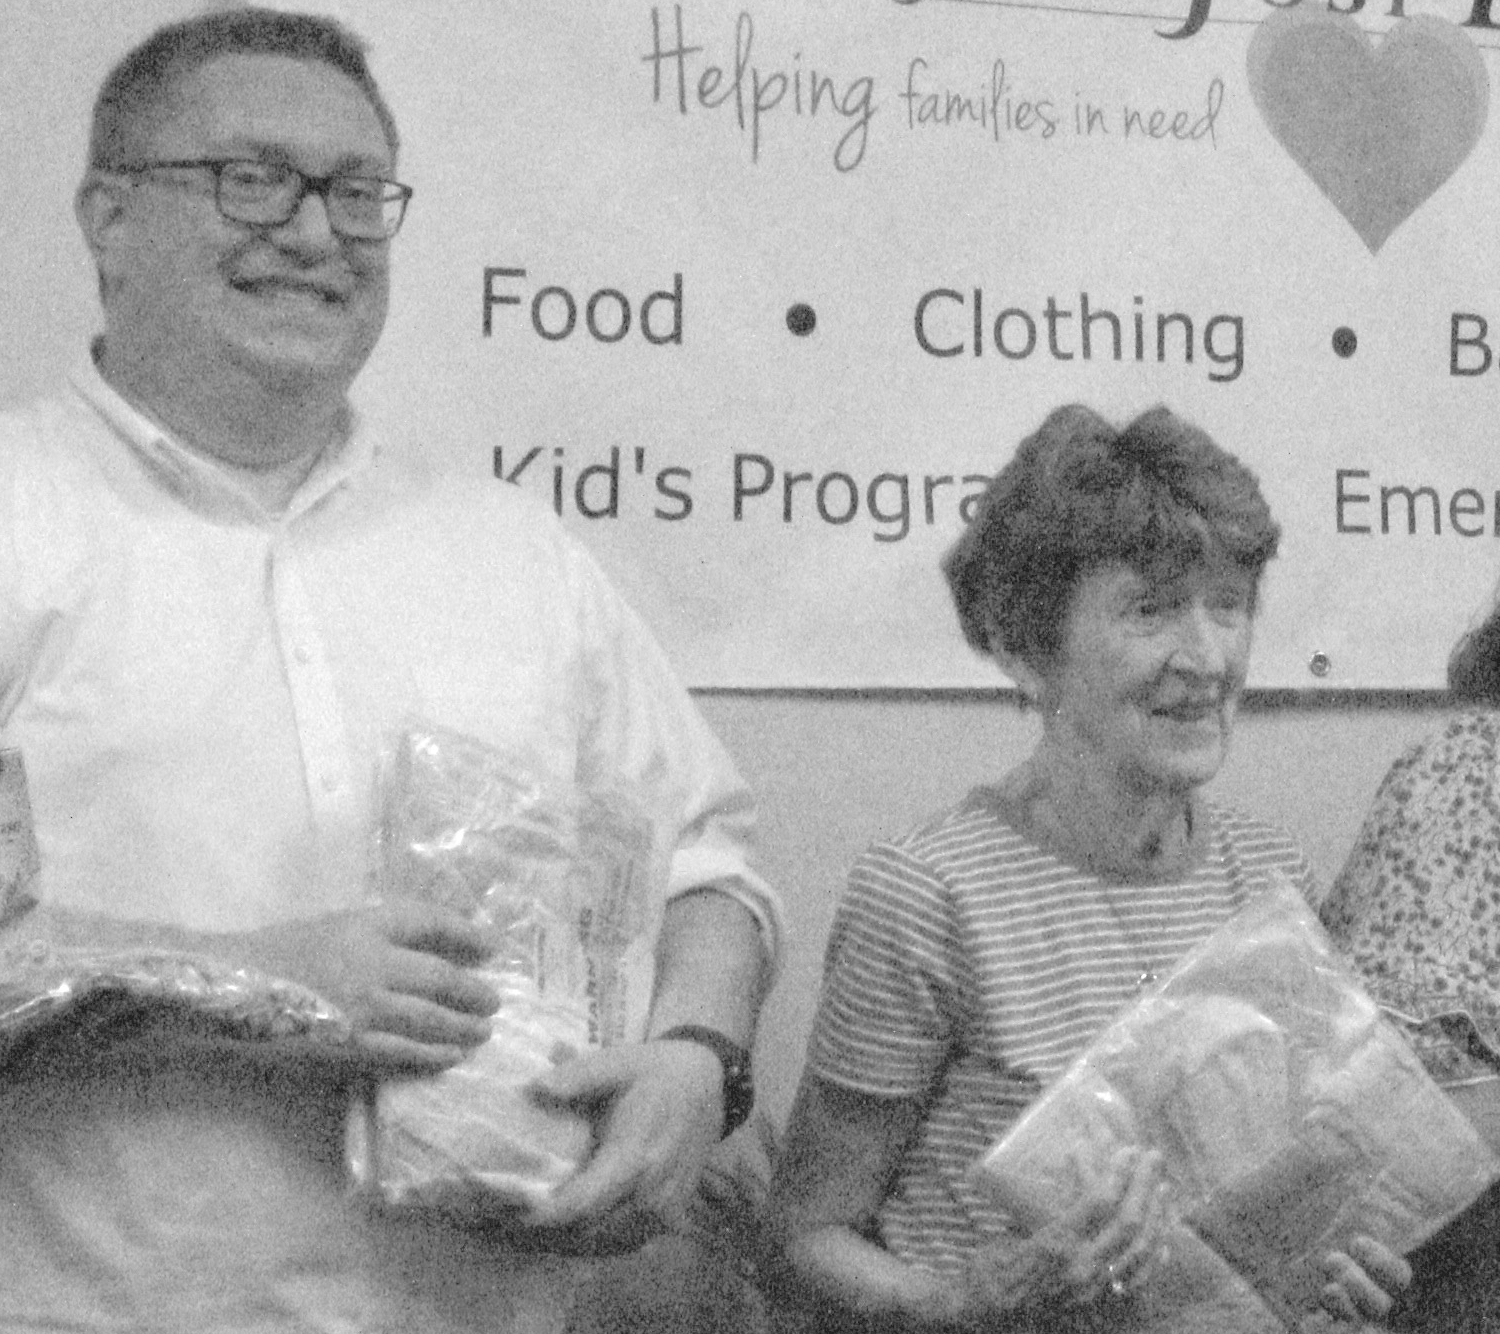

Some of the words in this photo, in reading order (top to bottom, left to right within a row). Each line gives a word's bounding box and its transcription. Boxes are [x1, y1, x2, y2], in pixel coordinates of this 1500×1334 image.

[641, 4, 878, 172] Helping
[898, 58, 1057, 141] families
[1073, 92, 1109, 137] in
[1124, 79, 1226, 151] need
[482, 266, 685, 346] Food
[914, 288, 1247, 383] Clothing
[492, 444, 693, 522] Kid's
[733, 453, 993, 542] Progra
